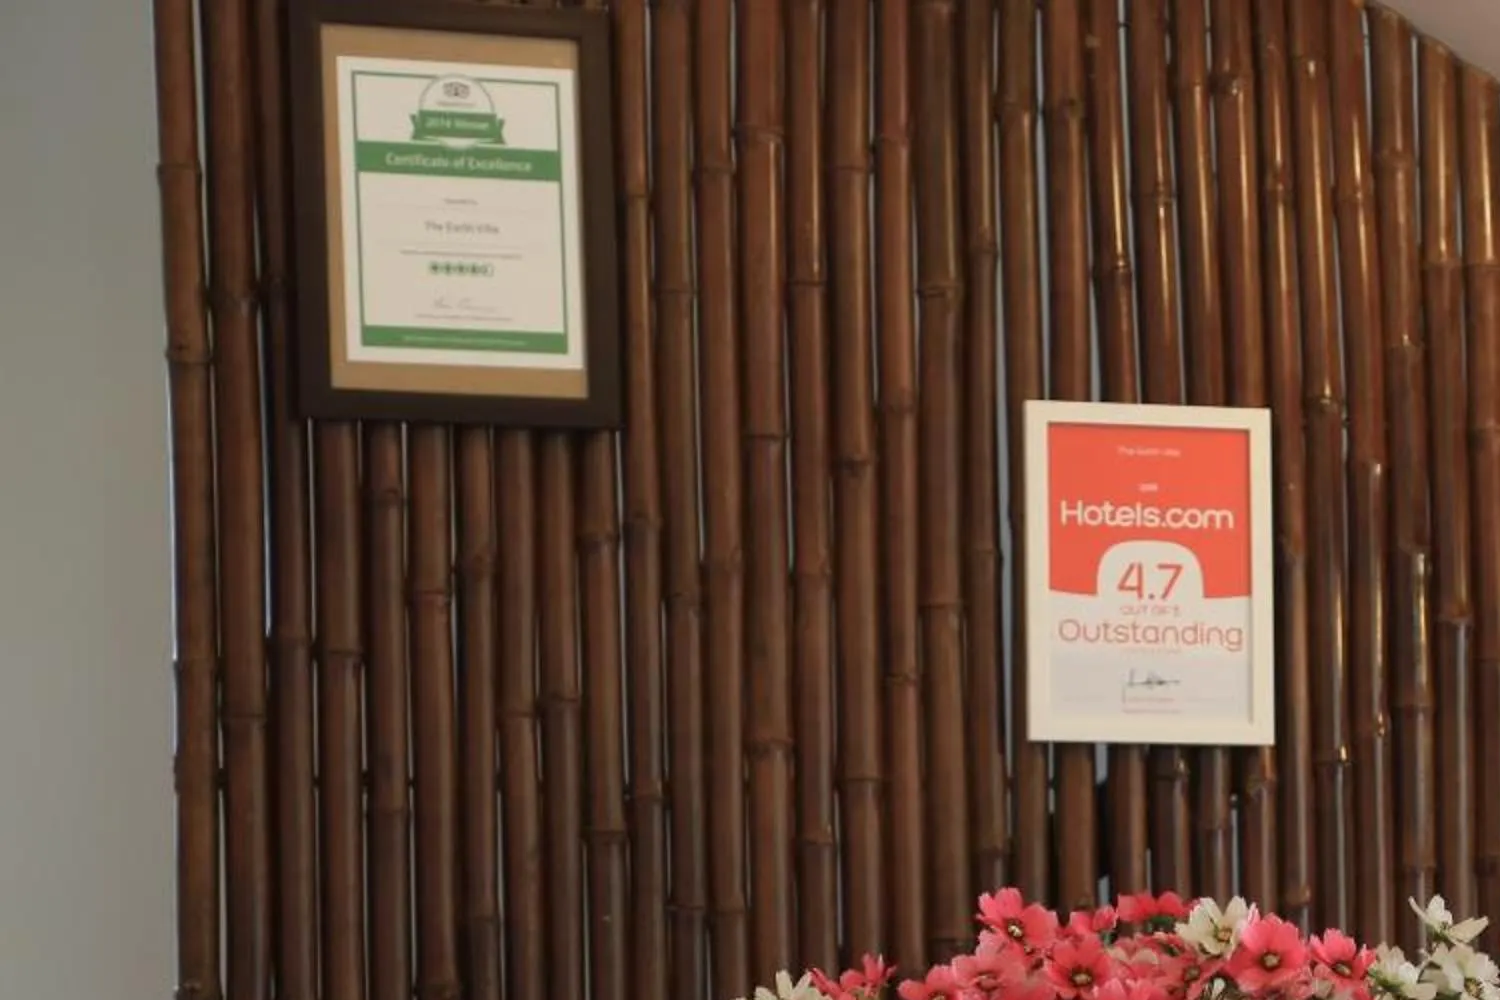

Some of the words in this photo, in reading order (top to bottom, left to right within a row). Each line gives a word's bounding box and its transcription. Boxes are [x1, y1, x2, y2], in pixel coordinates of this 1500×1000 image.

[385, 152, 449, 167] Certificate
[453, 156, 464, 168] of
[467, 157, 533, 172] Excellence
[1060, 499, 1235, 529] Hotels.com
[1117, 561, 1184, 601] 4.7
[1058, 618, 1244, 652] Outstanding
